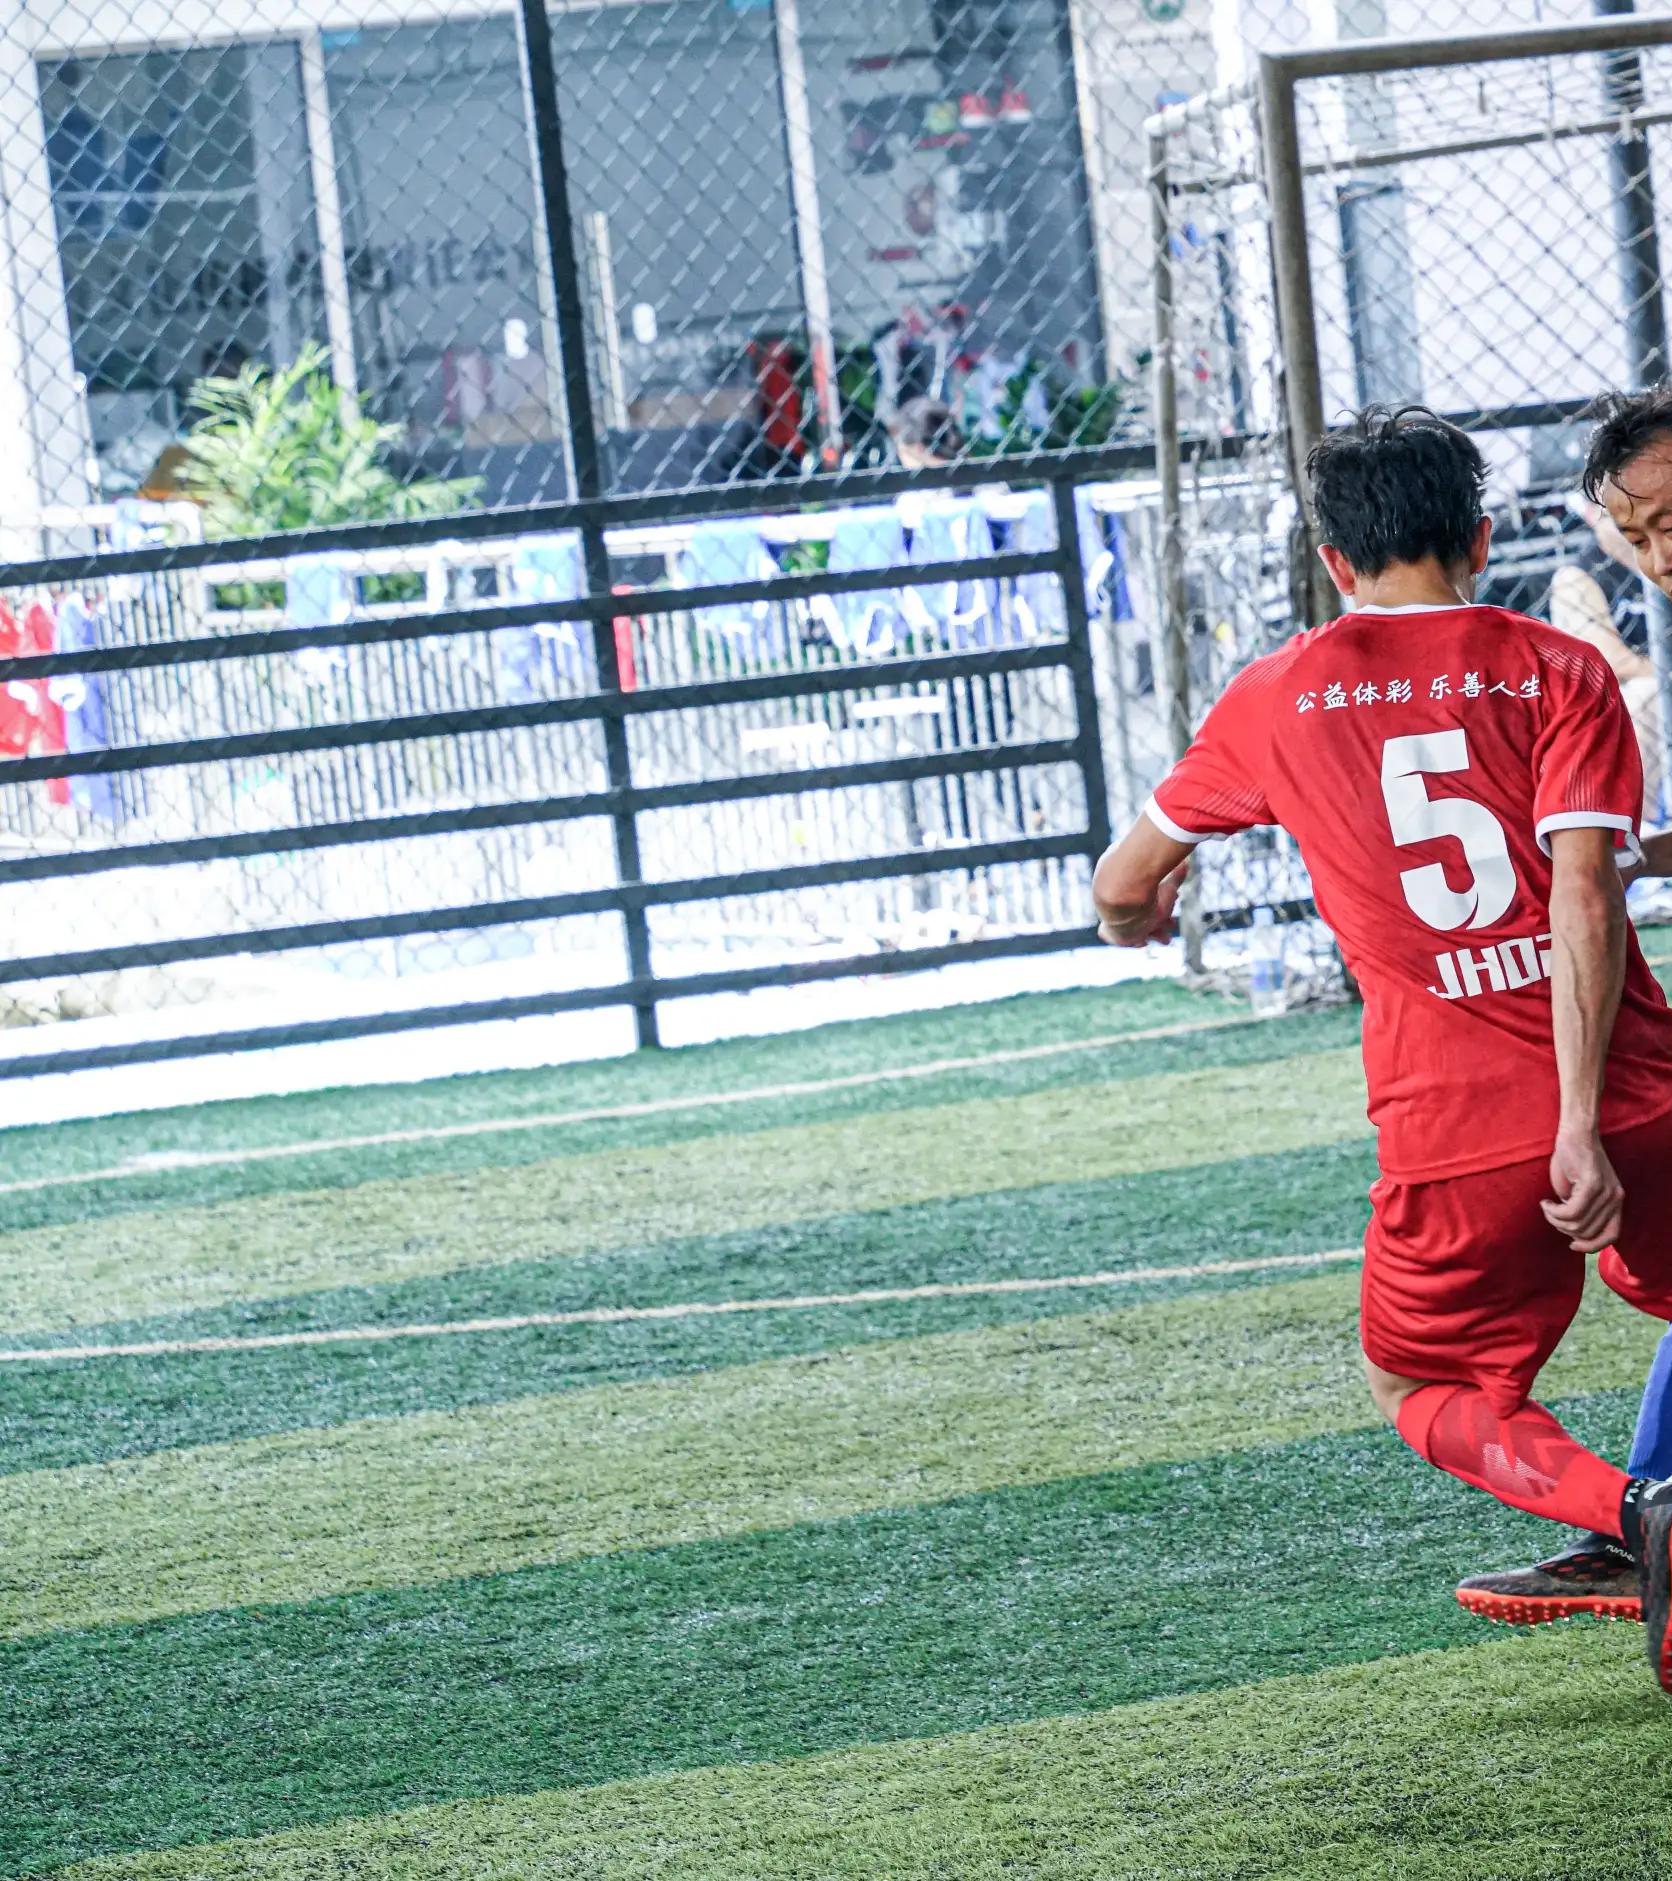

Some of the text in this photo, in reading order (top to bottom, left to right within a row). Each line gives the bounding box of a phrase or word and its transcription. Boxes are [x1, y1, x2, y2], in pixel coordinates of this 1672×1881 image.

[1296, 671, 1542, 713] 公益体彩 乐善人生
[1381, 728, 1517, 932] 5
